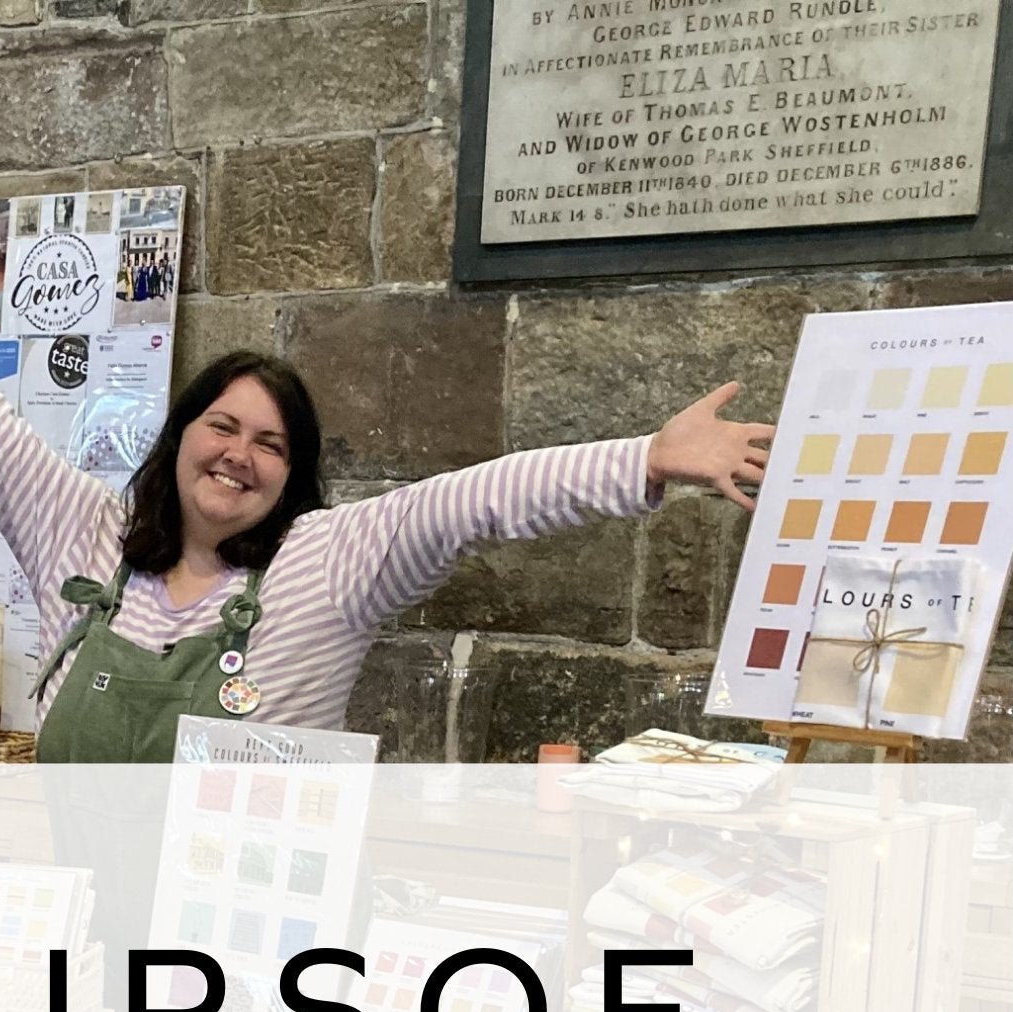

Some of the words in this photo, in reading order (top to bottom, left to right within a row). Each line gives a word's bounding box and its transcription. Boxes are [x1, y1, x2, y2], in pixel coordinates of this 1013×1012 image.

[532, 10, 554, 26] BY
[568, 1, 634, 21] ANNIE
[593, 20, 673, 43] GEORGE
[685, 8, 775, 33] EDWARD
[502, 62, 518, 77] IN
[525, 48, 653, 74] AFFECTIONATE
[660, 32, 804, 61] REMEMBRANCE
[812, 28, 832, 43] OF
[844, 21, 900, 40] THEIR
[905, 12, 980, 33] SISTER
[619, 66, 710, 99] ELIZA
[557, 111, 604, 129] WIFE
[612, 109, 636, 124] OF
[644, 100, 735, 121] THOMAS
[518, 140, 556, 158] AND
[566, 133, 639, 153] WIDOW
[648, 130, 672, 146] OF
[680, 121, 770, 143] GEORGE
[781, 106, 947, 134] WOSTENHOLM
[577, 161, 596, 175] OF
[605, 154, 695, 172] KENWOOD
[704, 148, 754, 165] PARK
[494, 187, 538, 203] BORN
[545, 179, 633, 199] DECEMBER
[726, 170, 769, 187] DIED
[776, 162, 881, 182] DECEMBER
[510, 209, 561, 226] MARK
[666, 196, 715, 216] hath
[718, 195, 768, 213] done
[776, 190, 828, 209] what
[835, 186, 874, 205] she
[37, 260, 79, 280] CASA
[11, 274, 105, 316] Gomez
[870, 338, 938, 351] COLOURS
[959, 336, 985, 345] TEA
[51, 349, 89, 375] taste
[928, 599, 943, 607] OF
[214, 748, 258, 763] COLOURS
